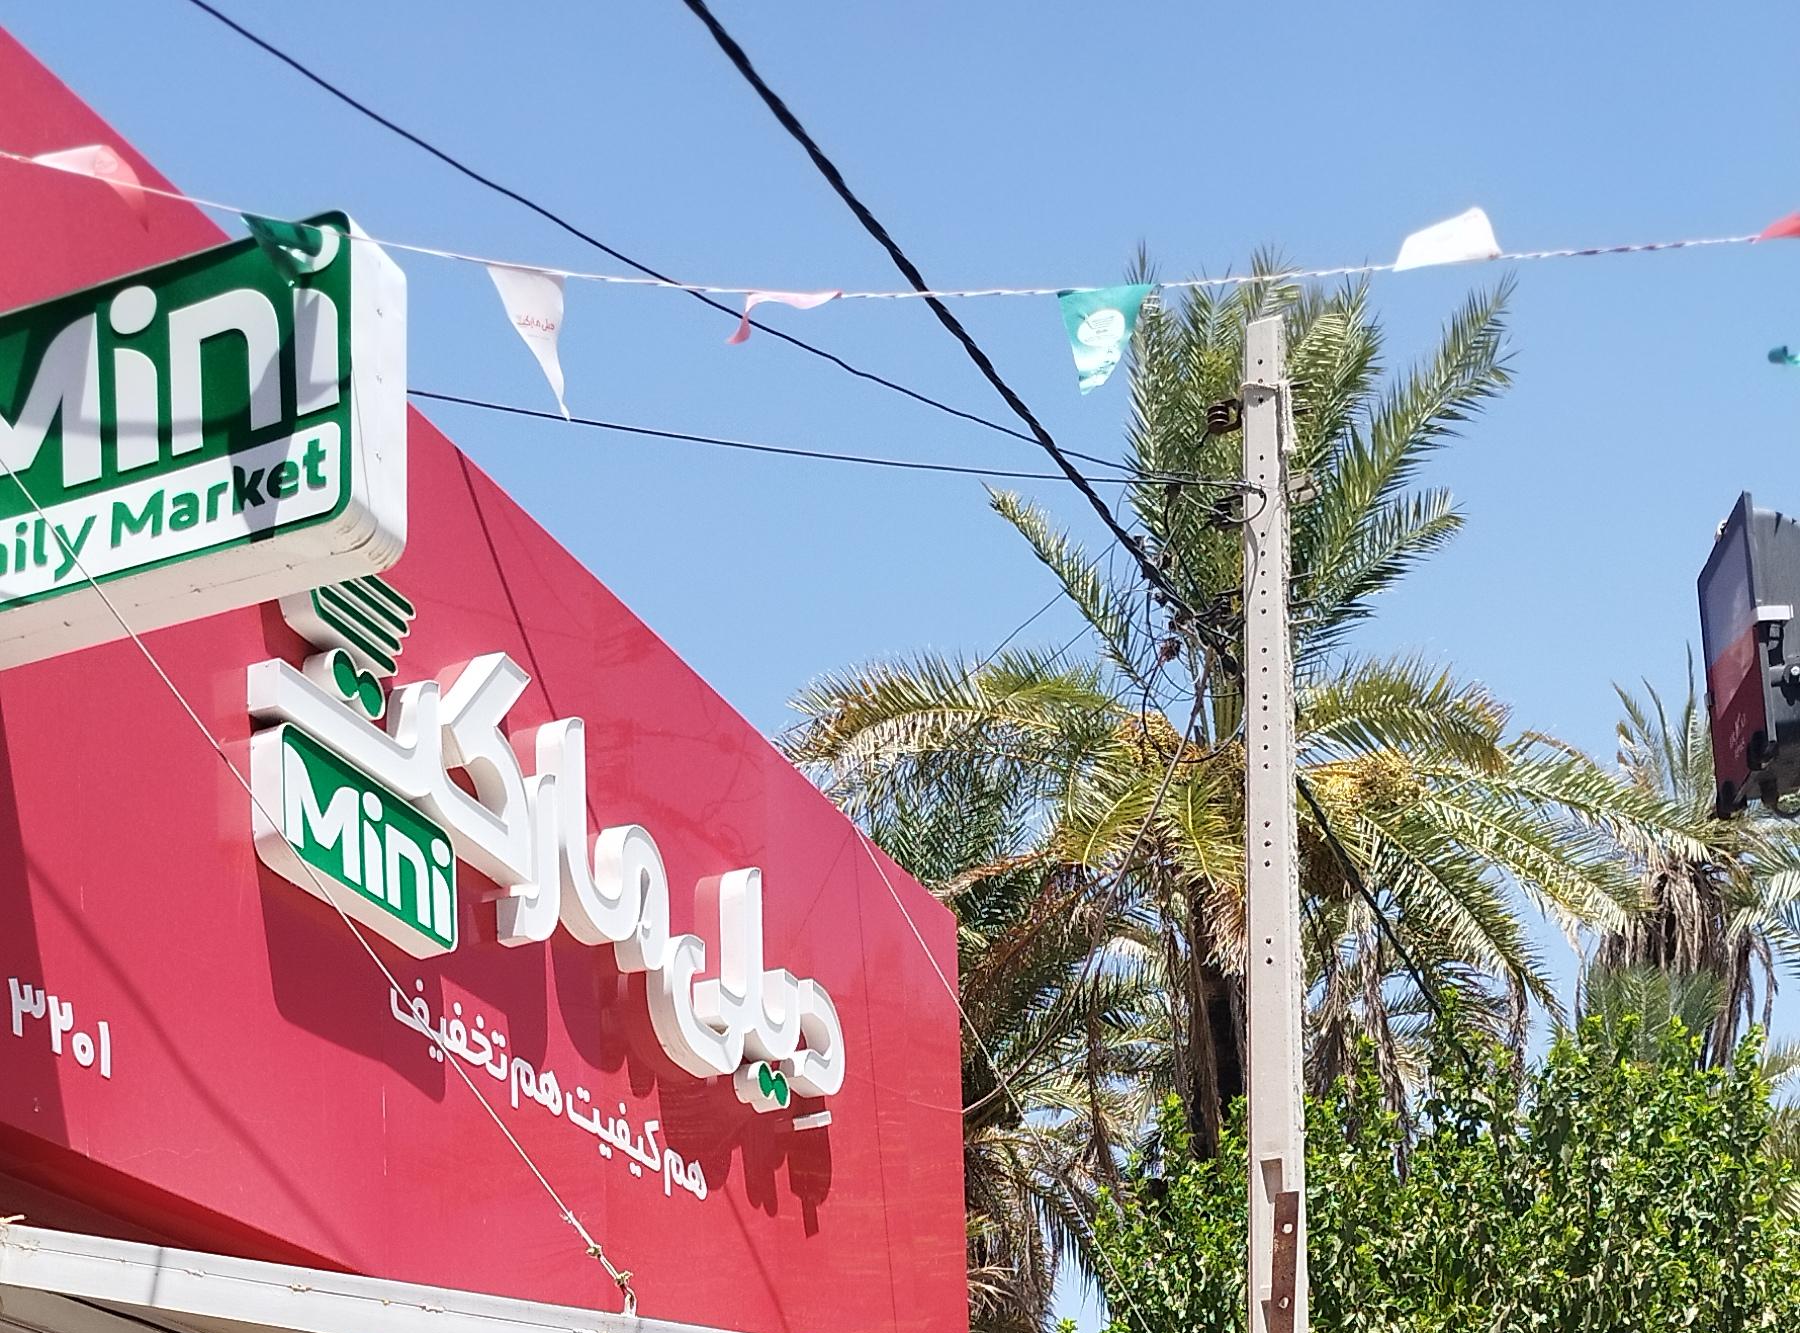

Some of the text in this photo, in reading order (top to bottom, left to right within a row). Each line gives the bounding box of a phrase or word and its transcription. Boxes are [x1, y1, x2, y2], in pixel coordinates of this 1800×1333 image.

[110, 437, 328, 551] Market
[284, 740, 453, 944] Mini
[8, 976, 112, 1079] ۳۲۰۱
[389, 977, 708, 1201] هم کیفیت هم تخفیف
